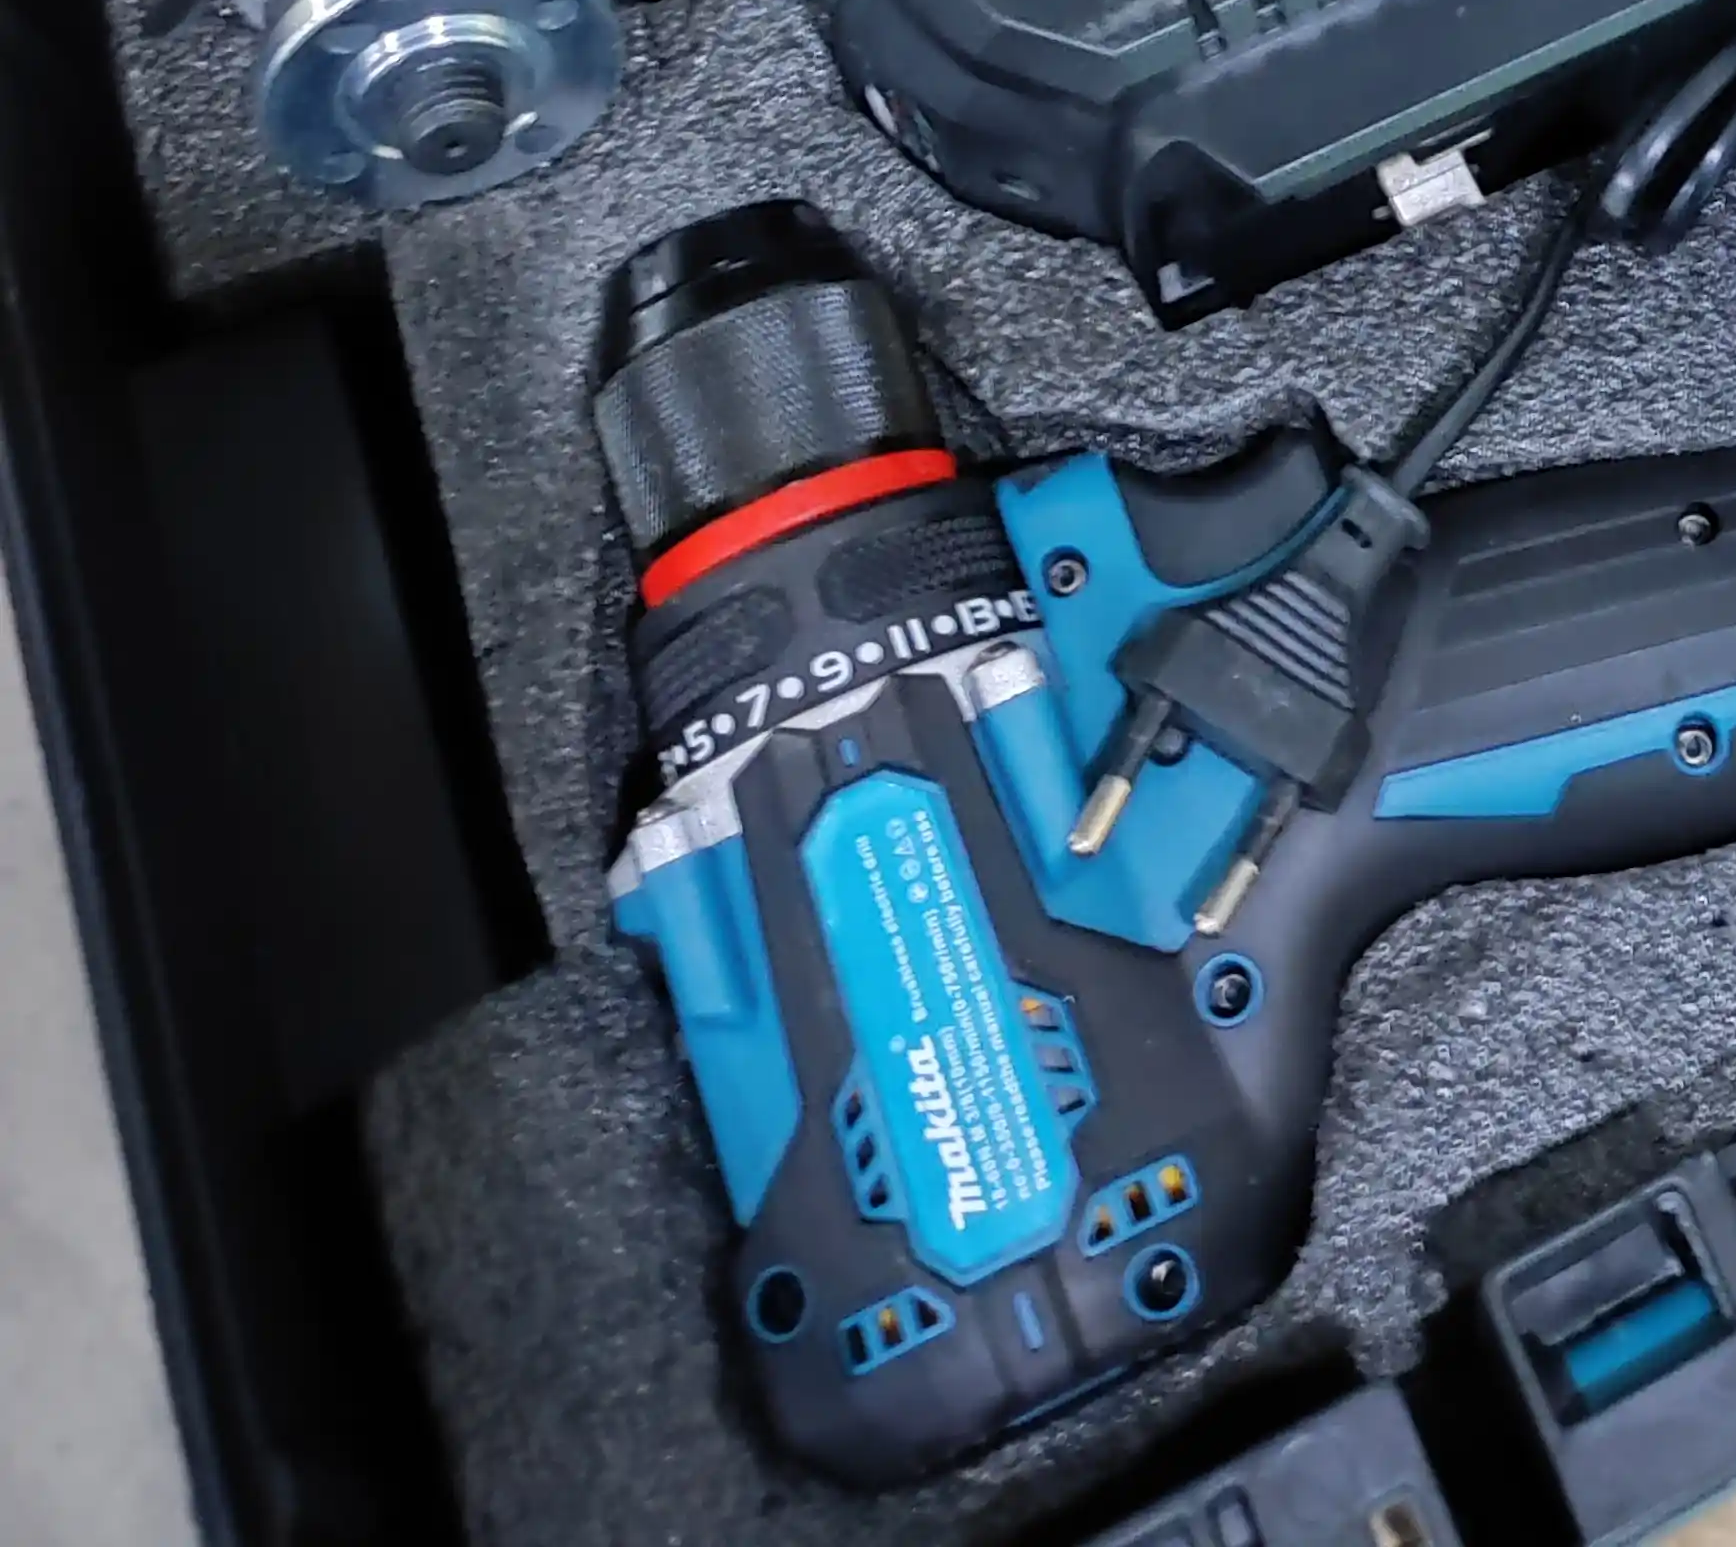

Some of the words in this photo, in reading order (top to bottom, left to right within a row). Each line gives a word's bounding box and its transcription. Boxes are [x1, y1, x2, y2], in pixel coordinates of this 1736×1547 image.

[682, 718, 716, 762] 5
[735, 683, 771, 728] 7
[810, 650, 854, 692] 9
[855, 834, 878, 870] drill
[912, 810, 935, 843] use
[868, 869, 900, 934] electric
[926, 844, 957, 904] before
[945, 904, 983, 982] carefully
[889, 934, 929, 1023] Brushless
[971, 983, 1006, 1051] manual
[907, 1034, 988, 1231] makita
[1018, 1123, 1053, 1192] Please
